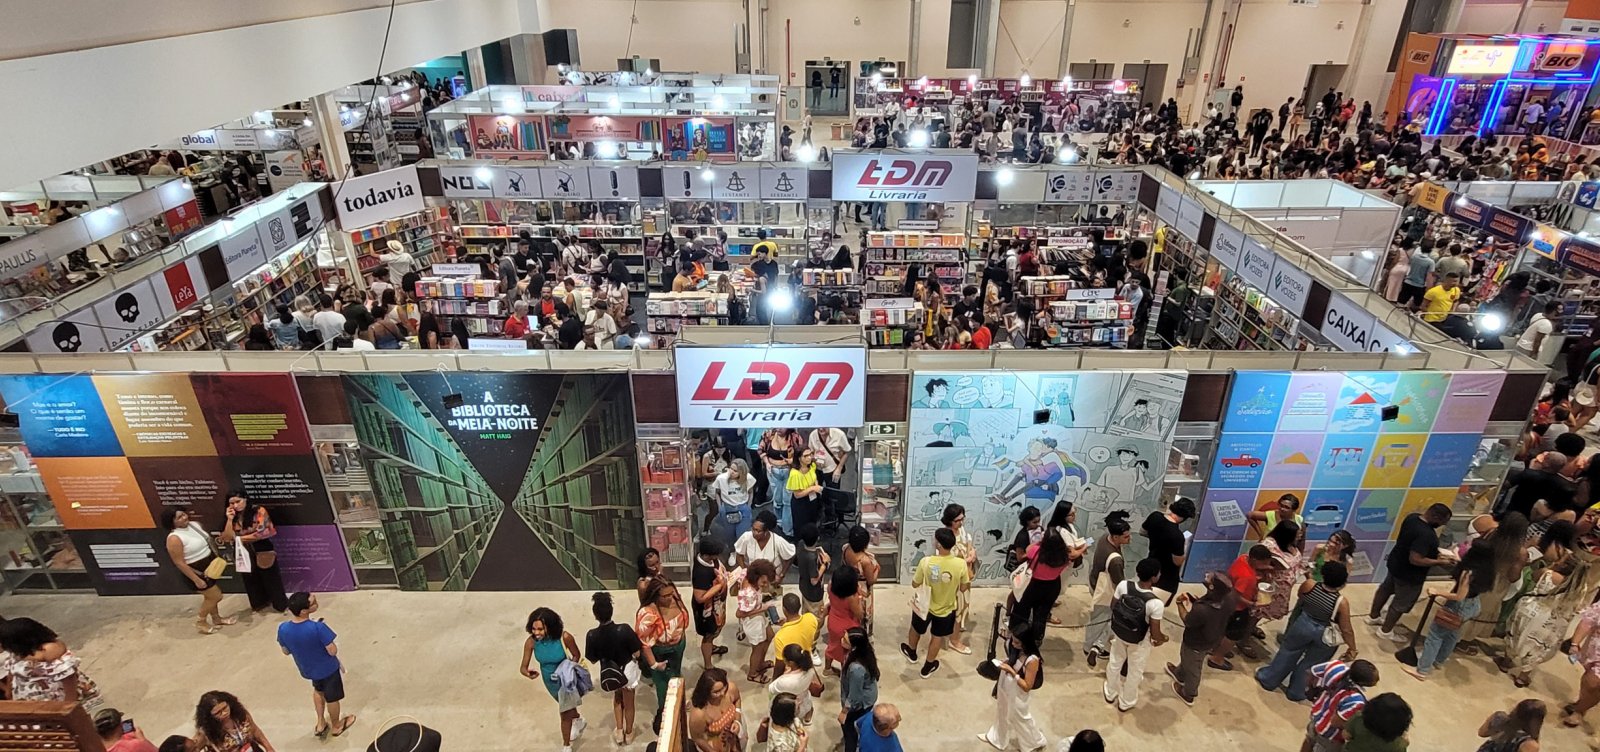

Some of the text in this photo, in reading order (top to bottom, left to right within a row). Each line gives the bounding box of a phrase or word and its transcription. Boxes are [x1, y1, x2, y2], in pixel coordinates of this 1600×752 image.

[1545, 56, 1579, 67] BIC
[182, 134, 215, 146] global
[858, 160, 953, 186] LDM
[344, 182, 415, 212] todavia
[869, 190, 927, 200] Livraria
[0, 250, 36, 272] PAULUS
[1250, 252, 1269, 270] EDITORA
[1249, 265, 1263, 278] VOZES
[1283, 272, 1304, 294] EDITORA
[1280, 284, 1297, 301] VOZES
[1327, 309, 1366, 349] CAIXA
[692, 362, 854, 400] LDM
[484, 391, 494, 402] A
[452, 404, 530, 416] BIBLIOTECA
[714, 408, 812, 421] Livraria
[458, 418, 538, 431] MEIA-NOITE
